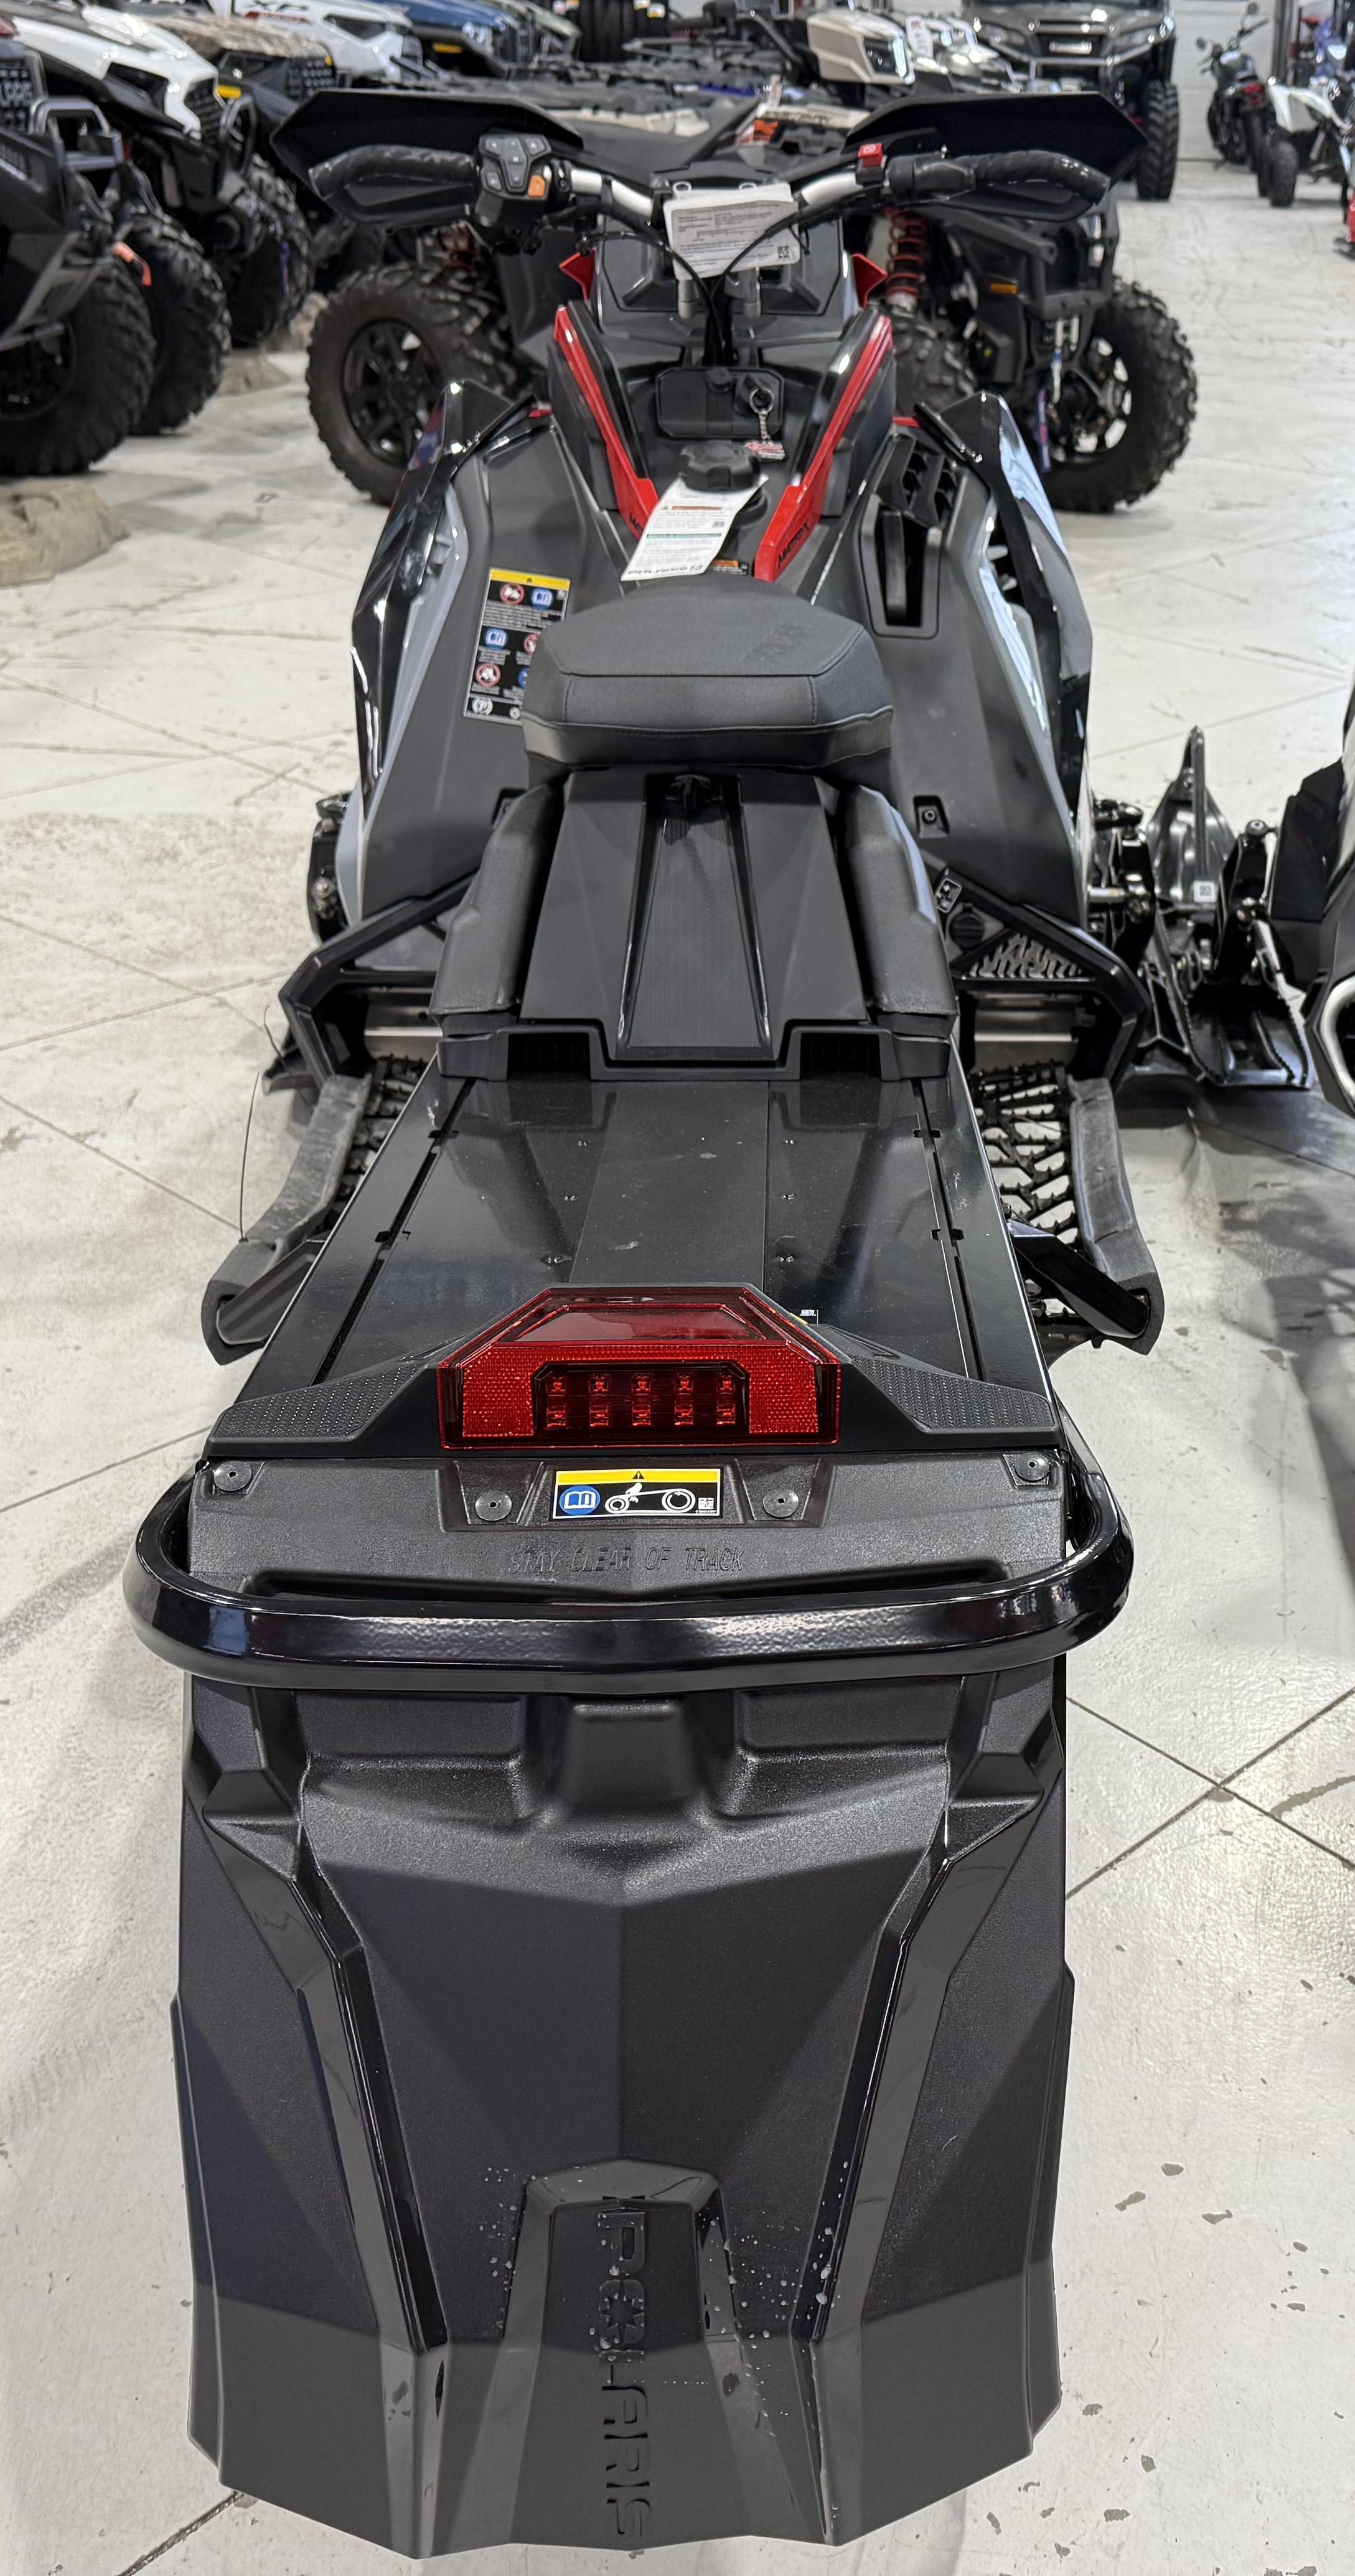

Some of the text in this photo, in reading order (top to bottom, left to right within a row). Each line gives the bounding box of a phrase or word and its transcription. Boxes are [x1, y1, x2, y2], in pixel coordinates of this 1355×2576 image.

[509, 1547, 746, 1573] STAY CLEAR OF TRACK
[598, 2195, 652, 2539] POLARIS
